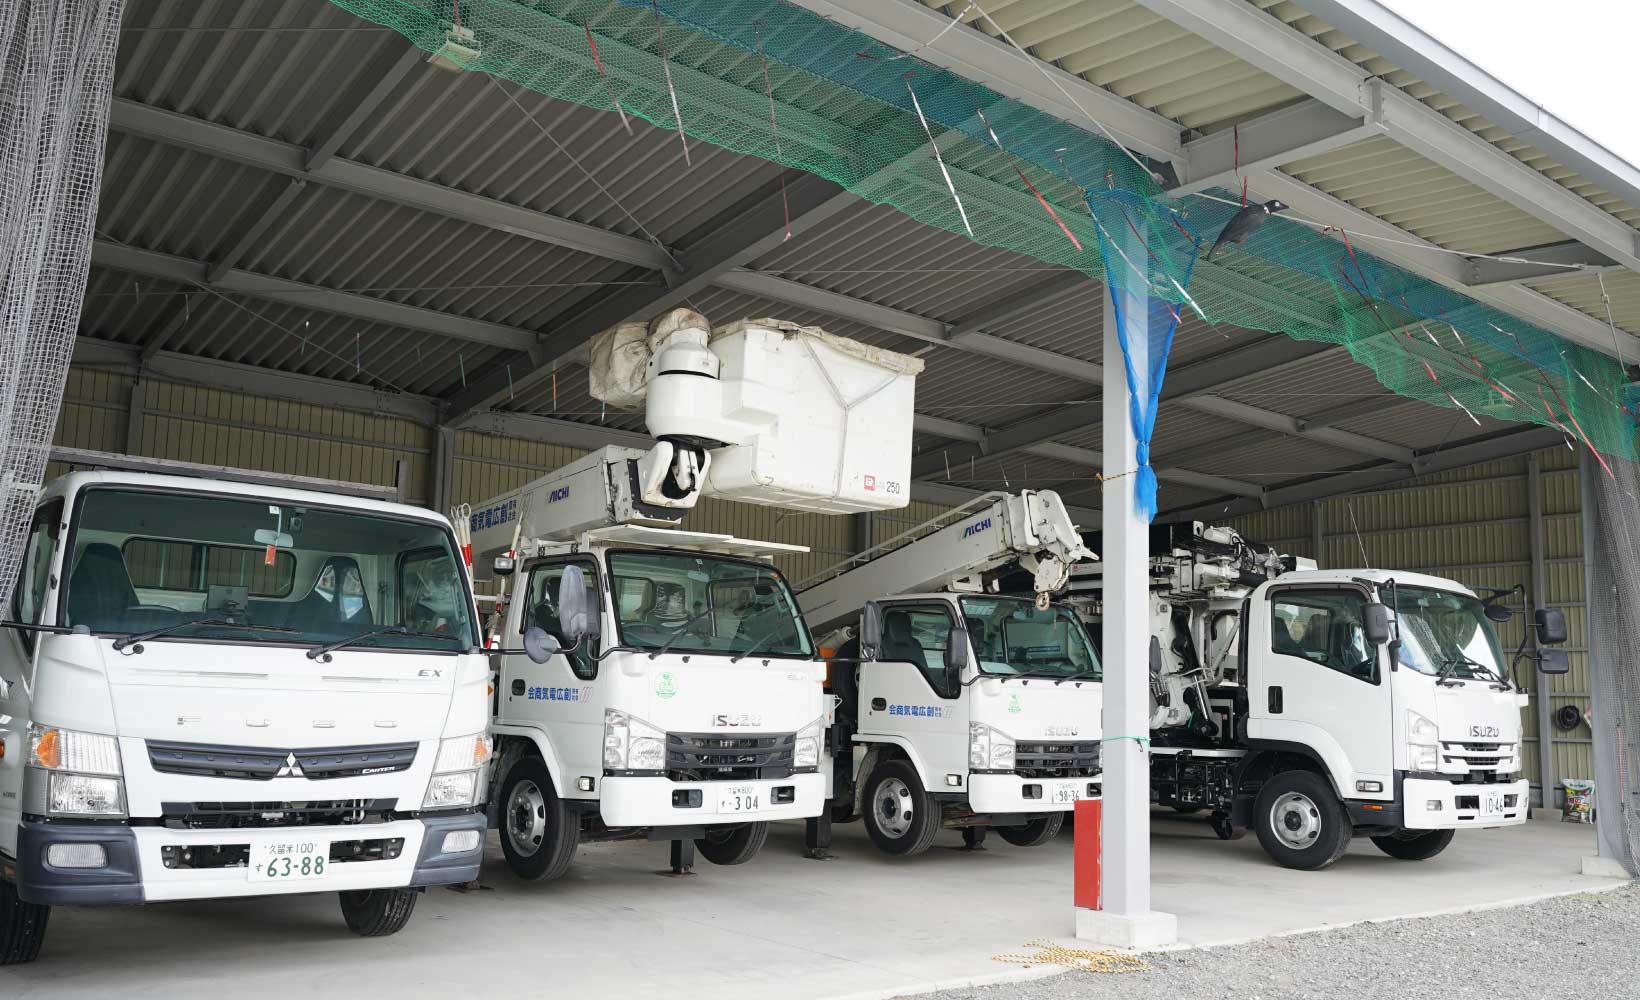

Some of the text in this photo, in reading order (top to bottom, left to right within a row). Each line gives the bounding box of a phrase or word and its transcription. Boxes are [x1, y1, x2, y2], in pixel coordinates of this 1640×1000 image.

[886, 481, 900, 494] 250
[548, 487, 570, 503] AICHI
[962, 518, 992, 539] AICHI
[418, 669, 442, 677] EX
[712, 714, 761, 727] ISUZU
[1470, 725, 1499, 737] ISUZU
[267, 856, 325, 877] 63-88
